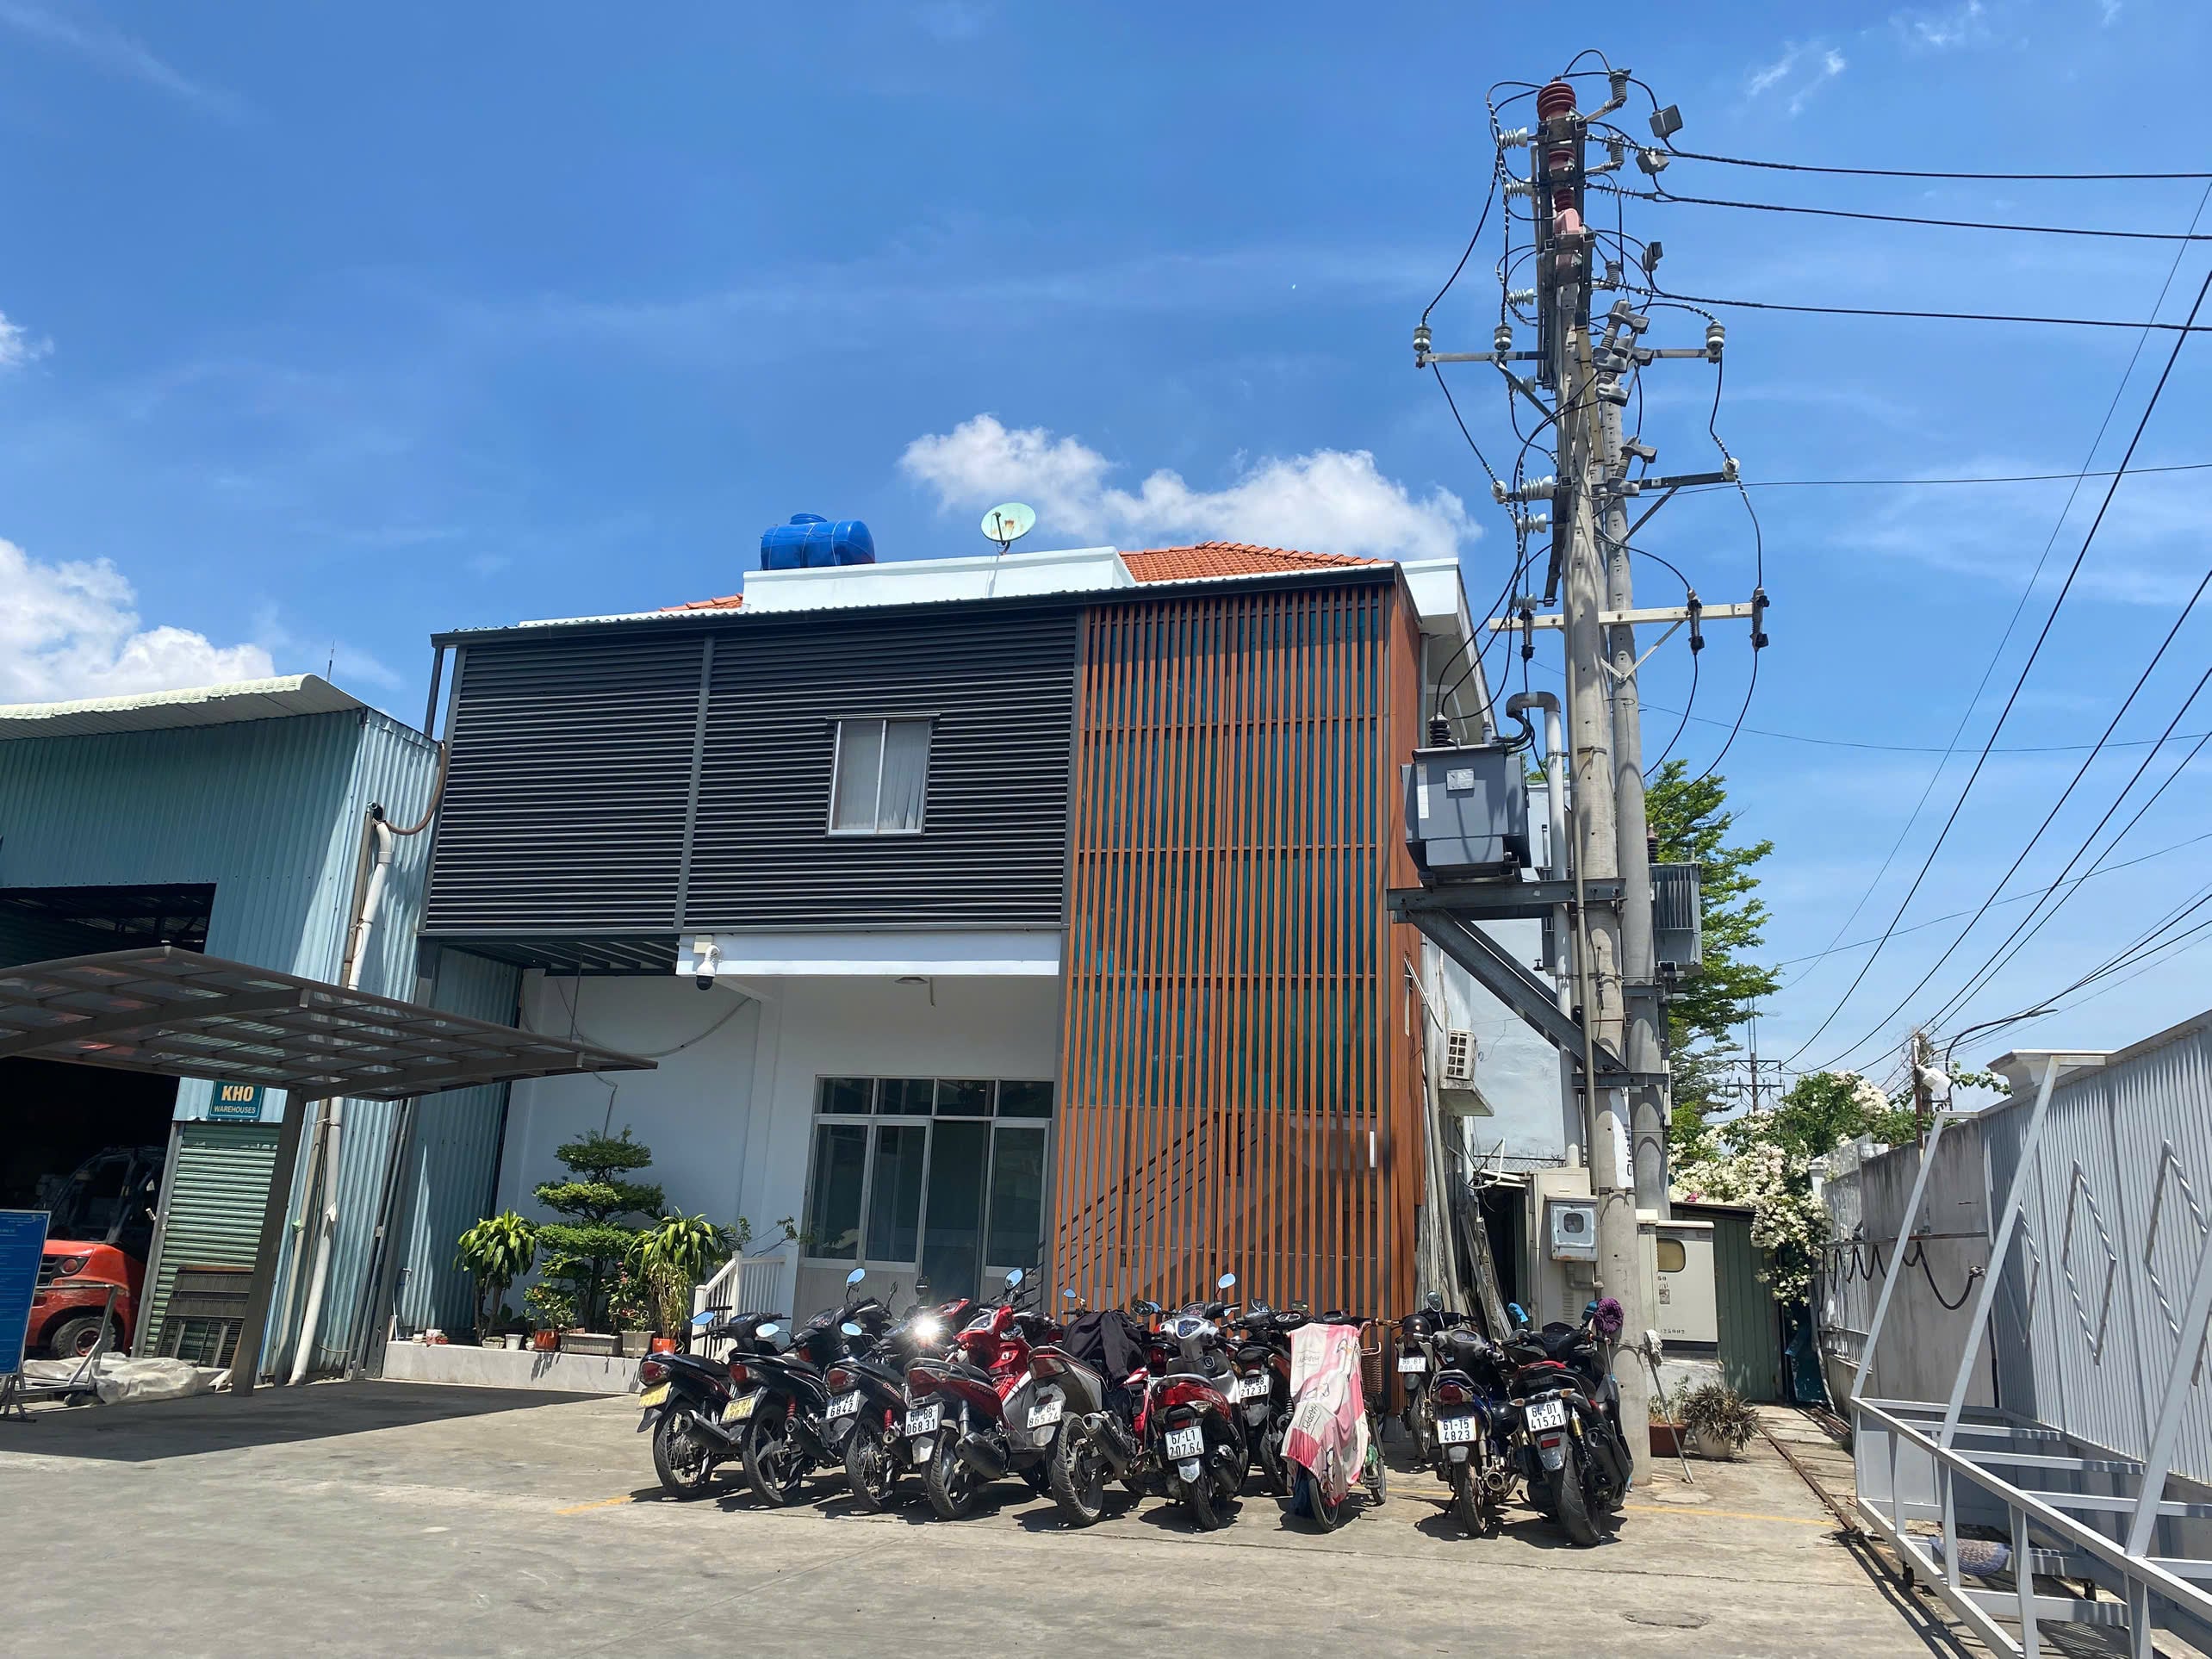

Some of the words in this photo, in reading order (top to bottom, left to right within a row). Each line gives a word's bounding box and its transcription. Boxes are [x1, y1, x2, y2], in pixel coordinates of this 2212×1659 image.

[221, 1085, 254, 1102] KHO
[830, 1402, 854, 1417] 6842
[1302, 1404, 1318, 1432] HAPPY
[1443, 1419, 1469, 1431] 61-T5
[1444, 1430, 1470, 1441] 4823
